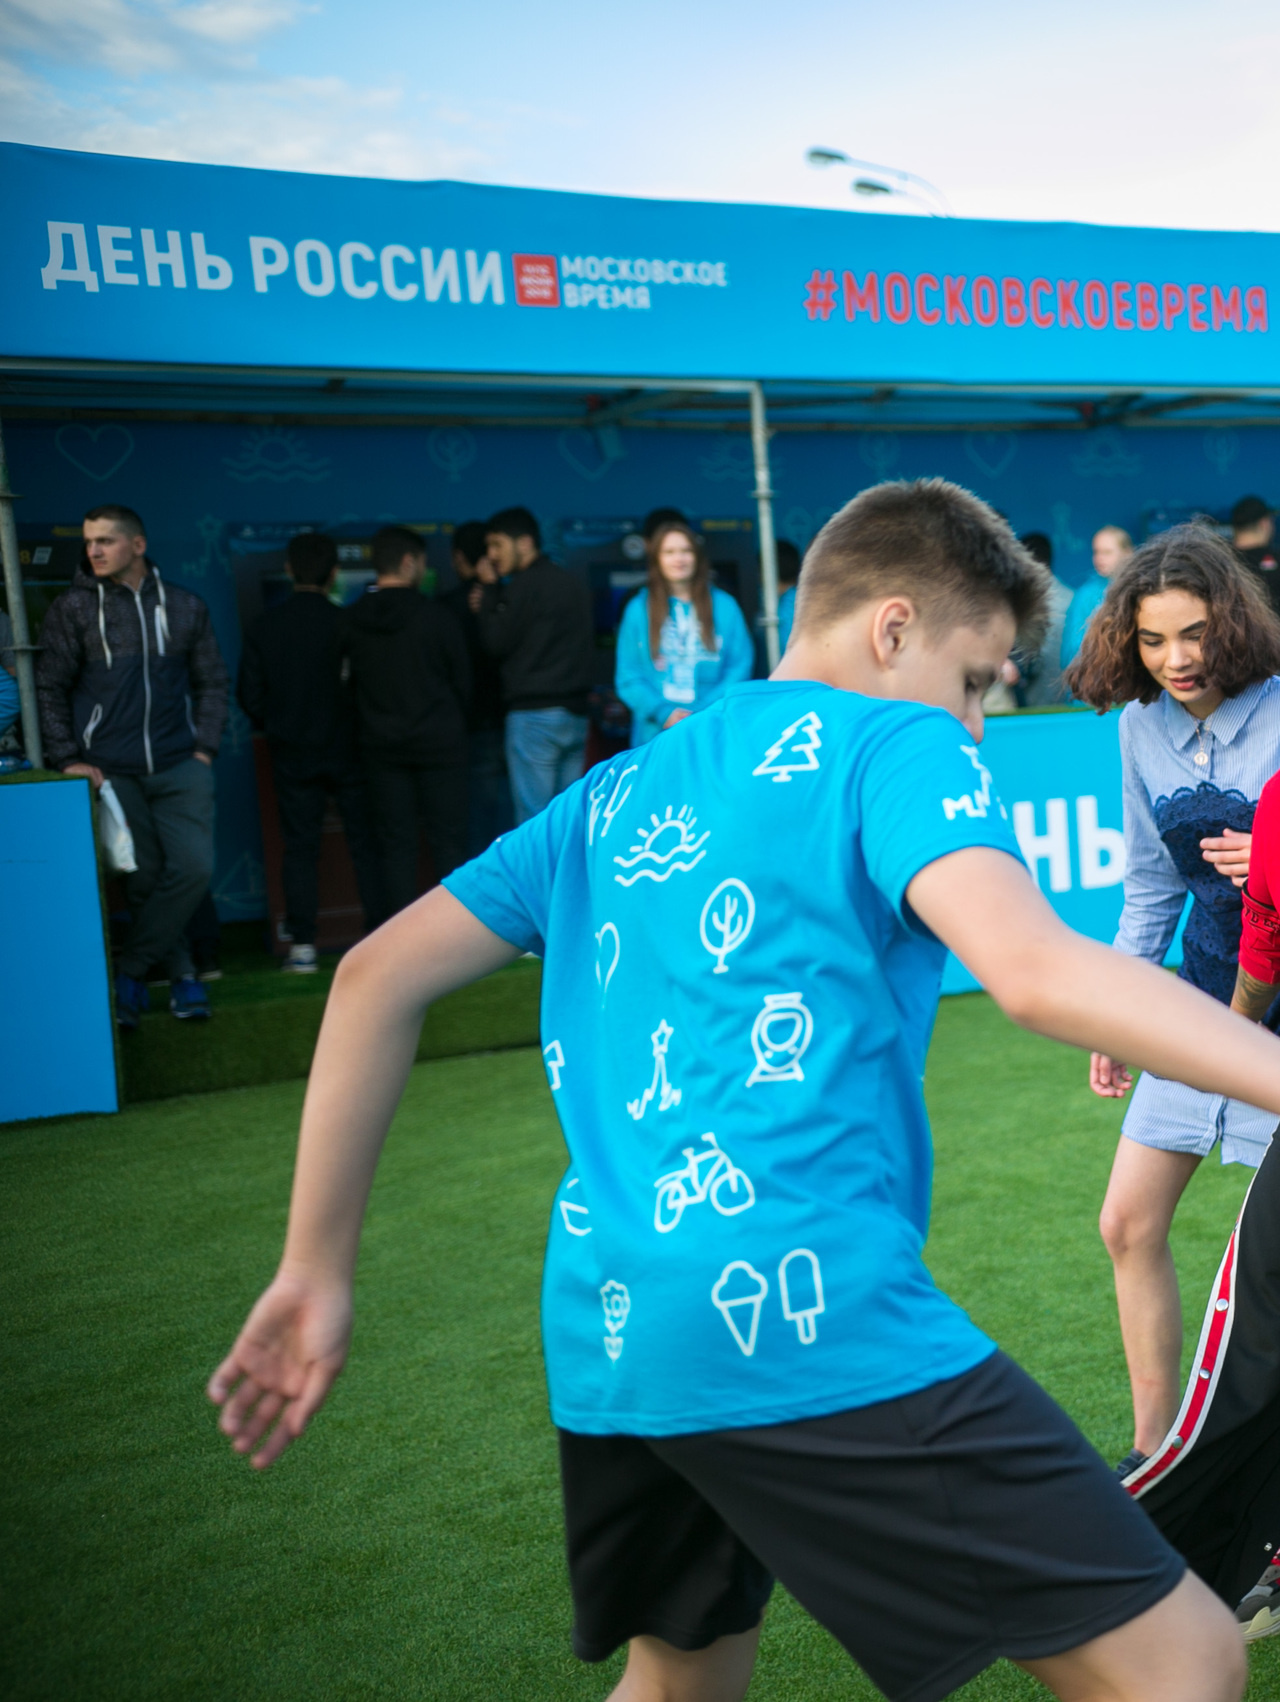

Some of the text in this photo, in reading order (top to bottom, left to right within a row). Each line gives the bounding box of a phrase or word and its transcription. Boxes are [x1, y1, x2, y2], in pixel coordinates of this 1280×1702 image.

[41, 219, 234, 293] ДЕНЬ
[249, 234, 506, 306] РОССИИ
[561, 254, 729, 288] МОСКОВСКОЕ
[563, 281, 652, 310] ВРЕМЯ
[802, 269, 1270, 333] #МОСКОВСКОЕВРЕМЯ
[1012, 794, 1128, 893] НЬ
